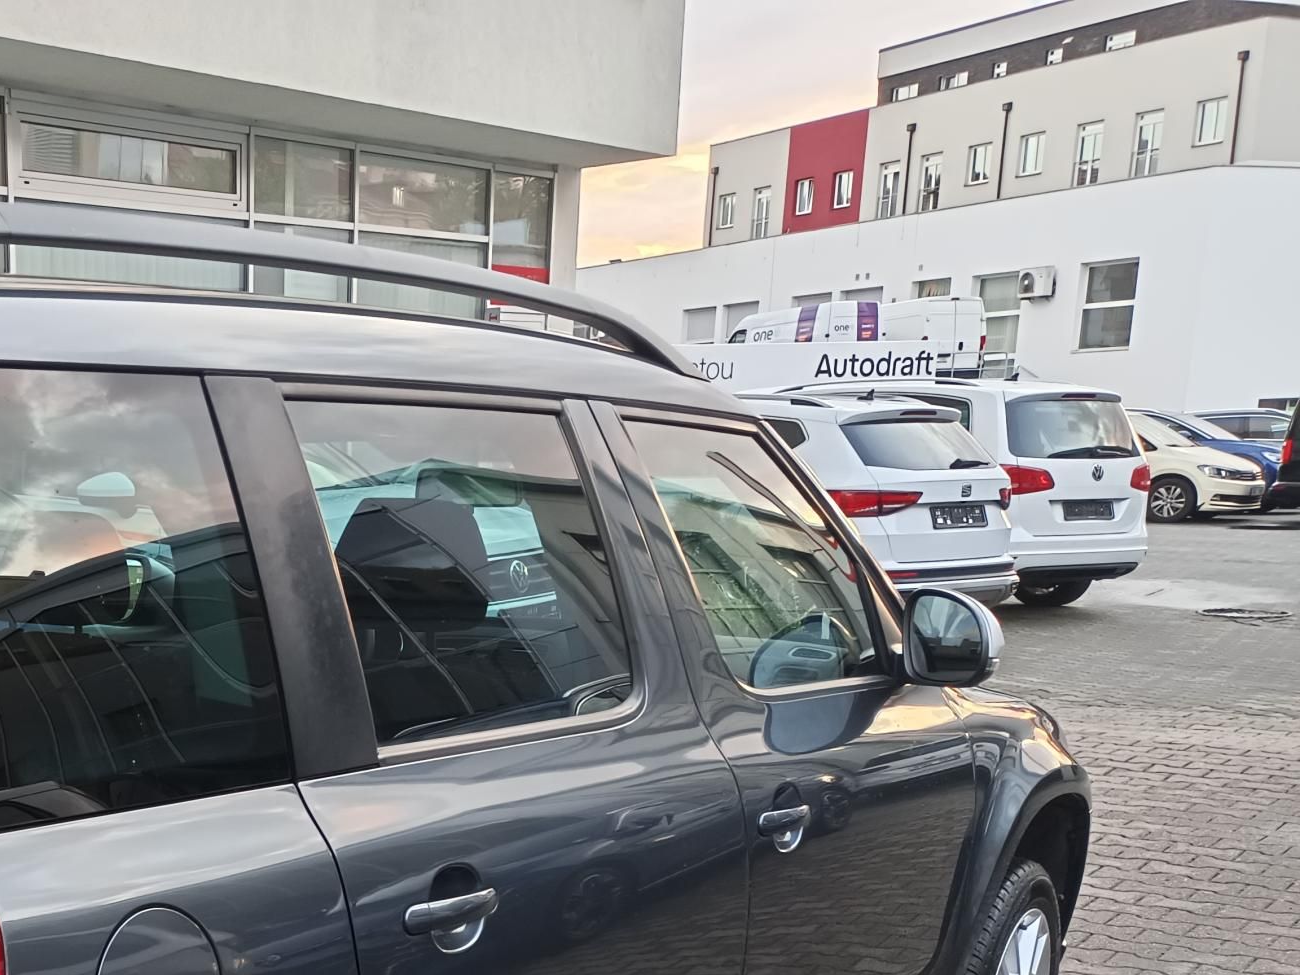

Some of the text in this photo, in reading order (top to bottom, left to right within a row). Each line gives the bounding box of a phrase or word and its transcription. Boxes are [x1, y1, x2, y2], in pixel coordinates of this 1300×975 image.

[753, 329, 774, 342] one
[834, 324, 850, 332] one
[692, 358, 733, 380] tou
[815, 350, 934, 378] Autodraft
